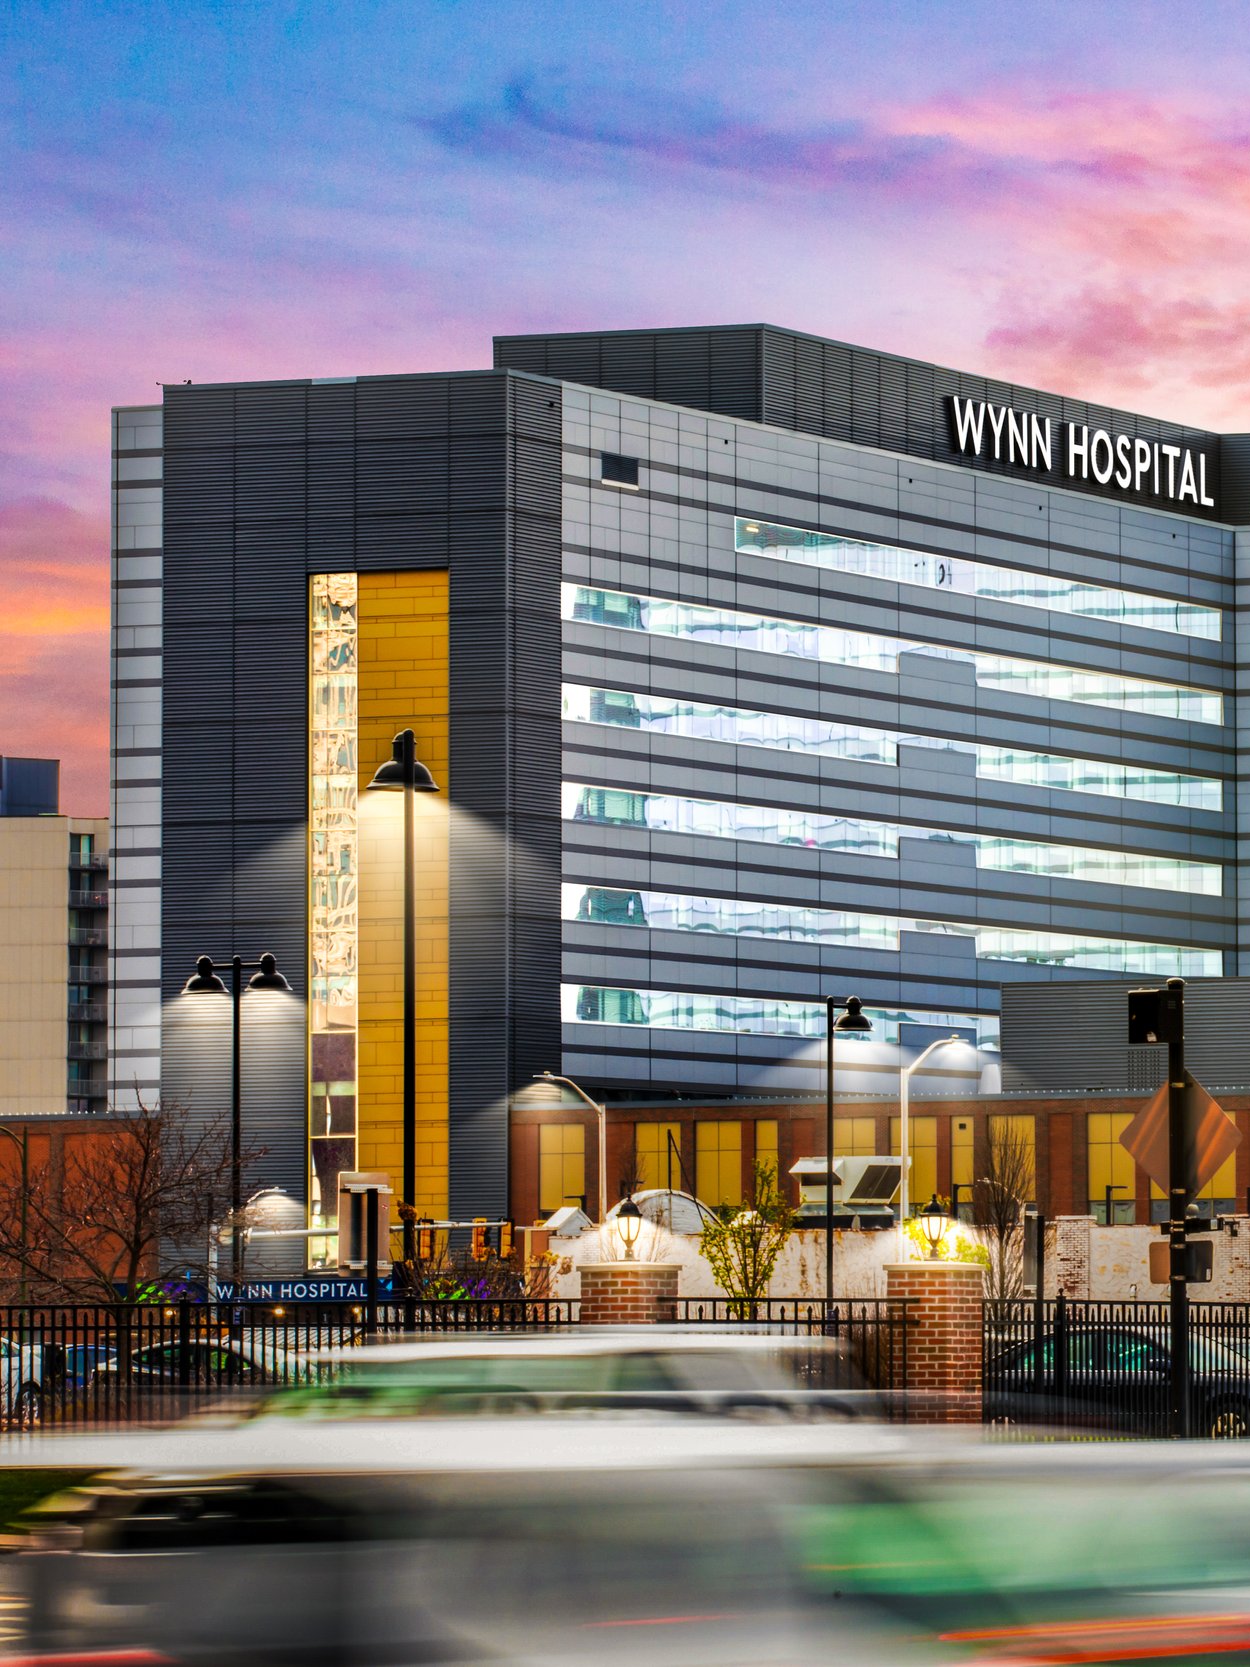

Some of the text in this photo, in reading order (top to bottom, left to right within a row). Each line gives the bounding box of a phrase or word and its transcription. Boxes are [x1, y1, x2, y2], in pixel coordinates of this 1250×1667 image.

[953, 396, 1214, 507] WYNN HOSPITAL
[217, 1283, 368, 1299] WNN HOSPITAL
